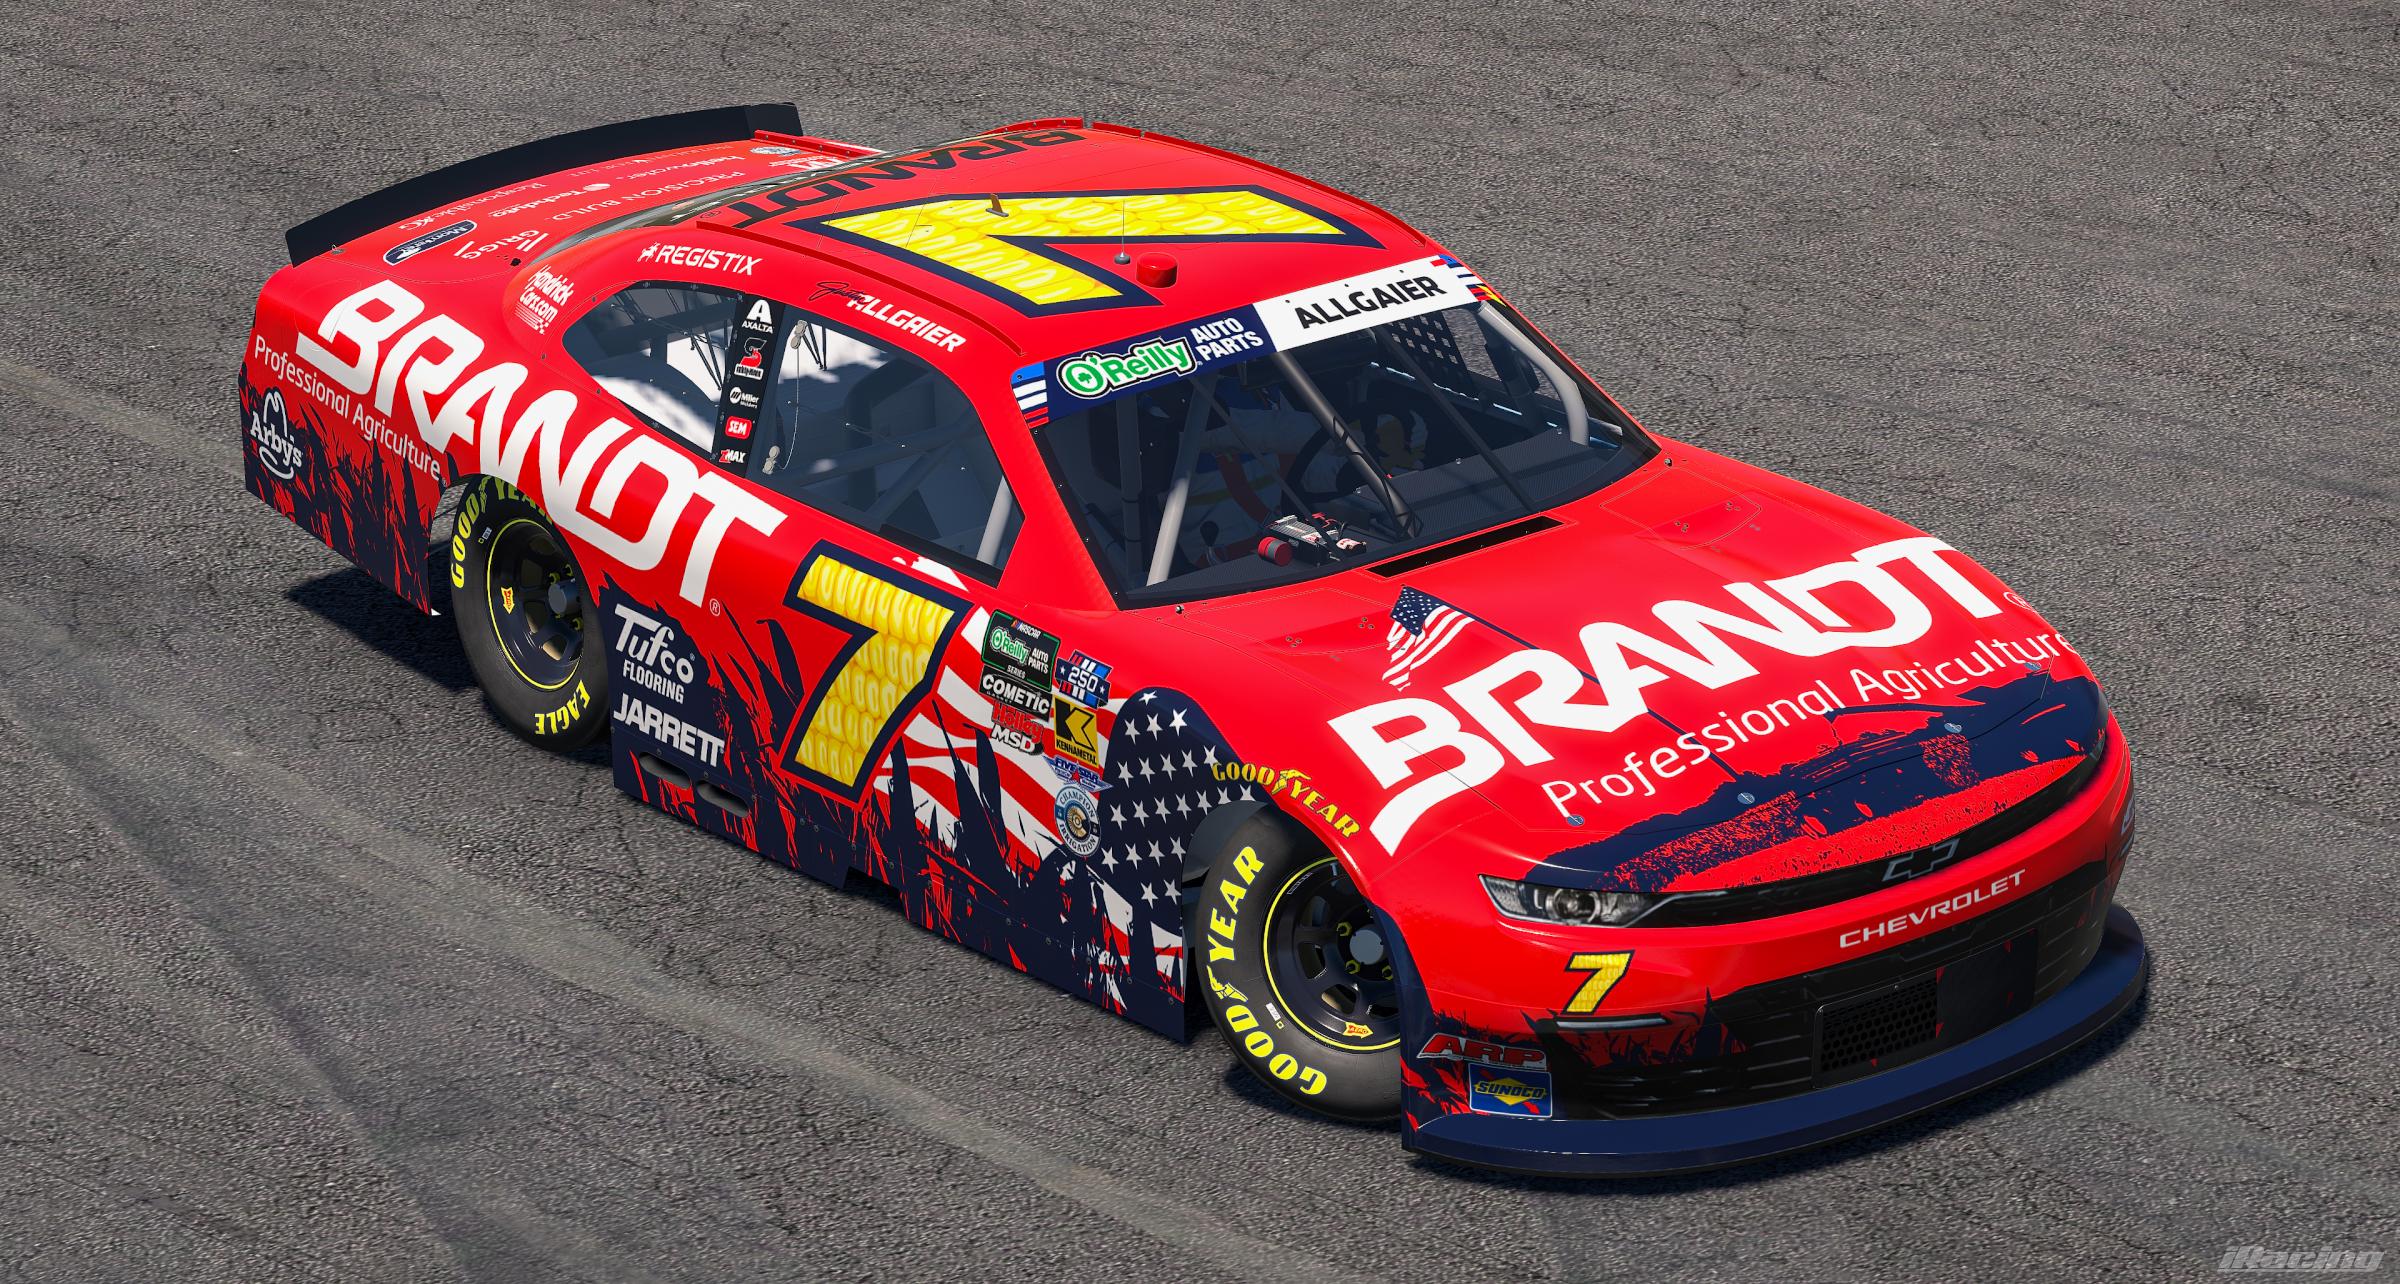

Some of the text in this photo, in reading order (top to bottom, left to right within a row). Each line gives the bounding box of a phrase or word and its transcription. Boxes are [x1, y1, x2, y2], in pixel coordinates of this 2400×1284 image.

[552, 171, 746, 221] PRECISION BUILD
[732, 129, 1085, 229] BRANDT
[461, 230, 539, 259] GRIGG
[656, 245, 763, 275] REGISTIX
[782, 184, 1387, 317] 7
[519, 287, 559, 322] Cars.com
[524, 264, 574, 307] Hendrick
[1294, 276, 1447, 330] ALLGAIER
[741, 320, 774, 334] AXALTA
[846, 293, 967, 352] ALLGAIER
[1190, 316, 1245, 346] AUTO
[1195, 330, 1265, 361] PARTS
[1060, 337, 1195, 397] O'Reilly
[254, 335, 441, 481] Professional Agriculture
[728, 420, 748, 435] SEM
[250, 411, 302, 468] Arby's
[296, 279, 788, 608] BRANDT
[614, 603, 694, 684] Tufco
[1031, 647, 1049, 663] AUTO
[622, 658, 684, 704] FLOORING
[782, 539, 974, 803] 7
[1007, 664, 1026, 679] SERIES
[1028, 656, 1049, 674] PARTS
[1067, 666, 1099, 692] 250
[535, 679, 590, 735] EAGLE
[982, 674, 1050, 714] COMETIC
[1327, 536, 2003, 857] BRANDT
[613, 692, 725, 767] JARRETT
[991, 724, 1036, 753] MSD
[992, 702, 1044, 743] Holley
[1541, 632, 2082, 819] Professional Agriculture
[1055, 757, 1077, 772] FIVE
[1078, 766, 1099, 781] STAR
[1056, 740, 1098, 765] KENNAMETAL
[1060, 790, 1096, 818] CHAMPION
[1060, 823, 1096, 853] IRRIGATION
[1840, 869, 2026, 948] CHEVROLET
[1560, 949, 1636, 1016] 7
[1420, 1033, 1547, 1068] ARP
[1476, 1080, 1545, 1099] SUNOCO
